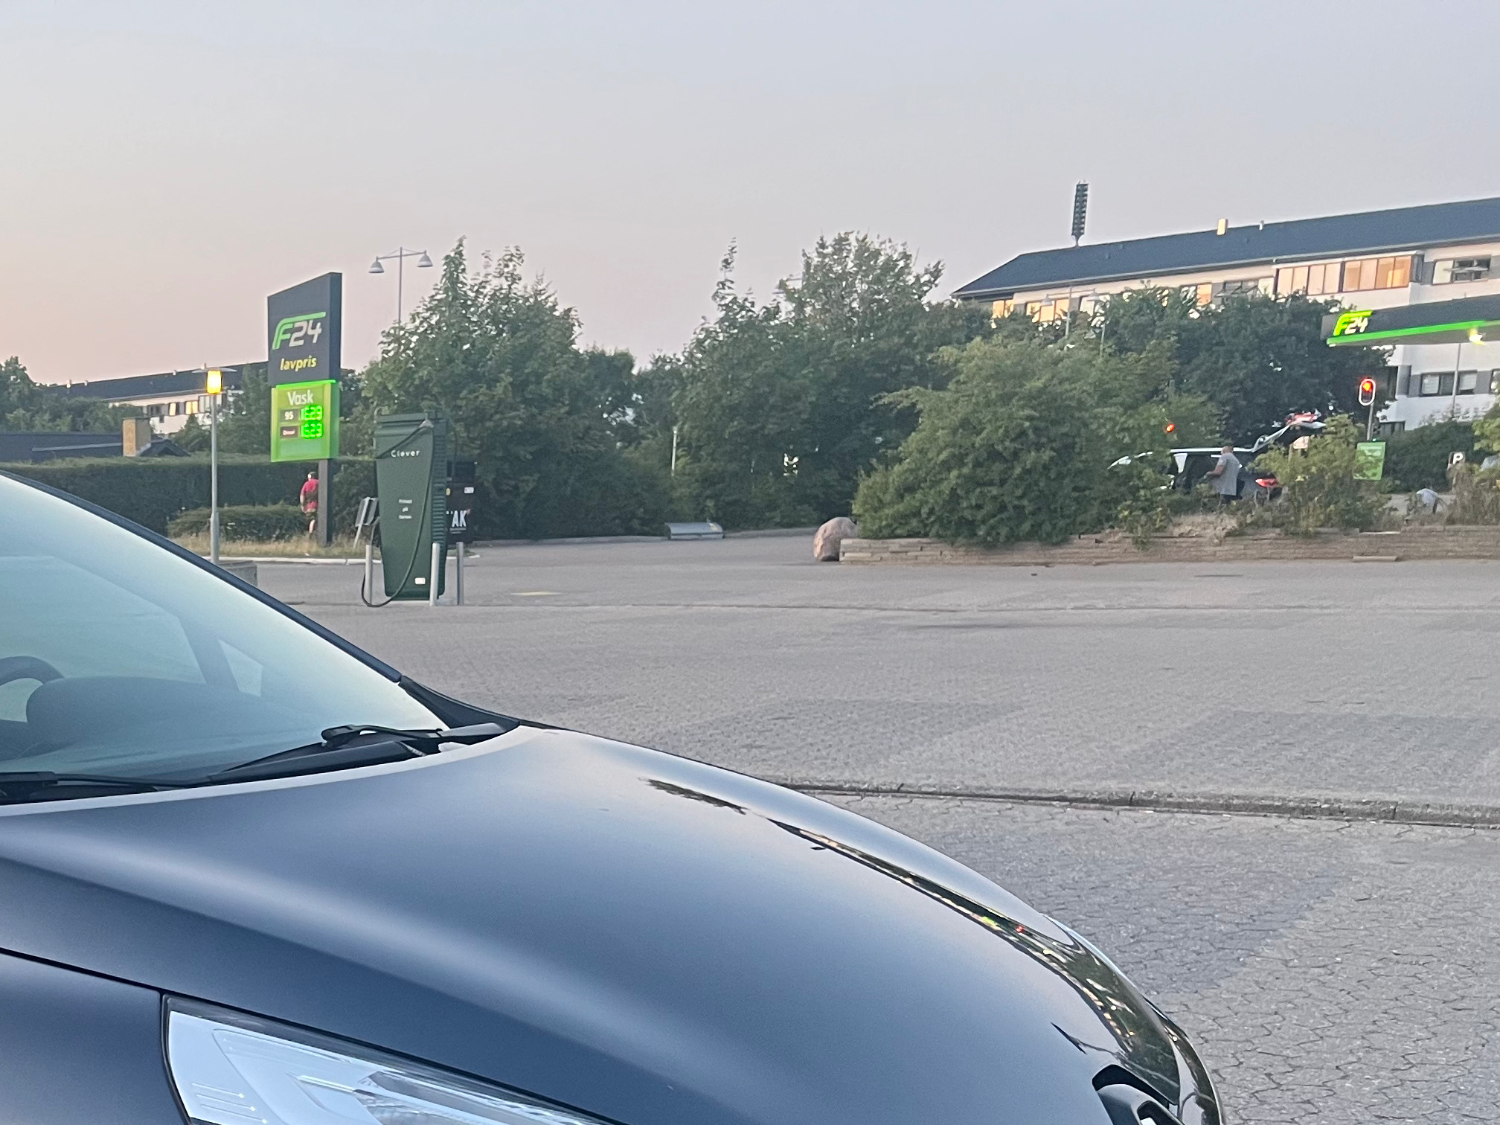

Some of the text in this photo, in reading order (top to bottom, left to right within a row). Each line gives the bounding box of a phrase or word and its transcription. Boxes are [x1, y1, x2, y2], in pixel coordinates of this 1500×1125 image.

[272, 312, 327, 350] F24
[1333, 311, 1373, 337] F24
[280, 355, 317, 372] lavpris
[287, 389, 313, 406] Vask
[284, 411, 294, 420] 95
[1453, 452, 1463, 465] P
